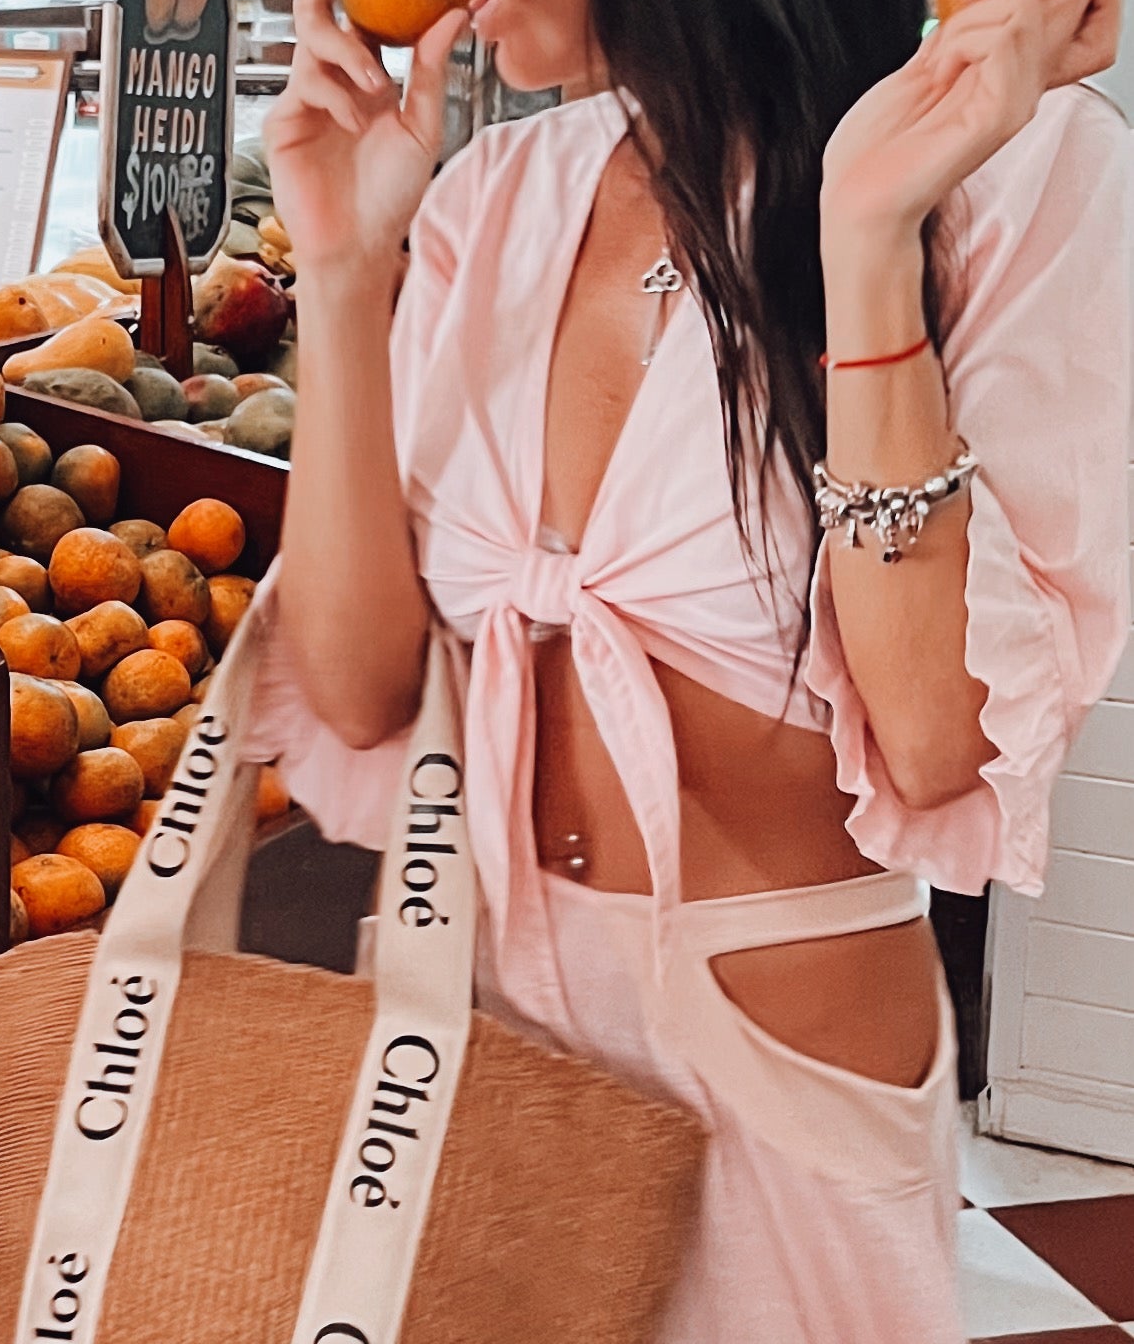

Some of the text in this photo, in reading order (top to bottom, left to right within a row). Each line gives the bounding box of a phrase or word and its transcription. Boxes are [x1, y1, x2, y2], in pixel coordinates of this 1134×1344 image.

[126, 47, 216, 99] MANGO
[133, 104, 206, 154] HEIDI
[399, 753, 462, 928] Chloé
[75, 975, 157, 1141] Chloé
[349, 1033, 440, 1210] Chloé
